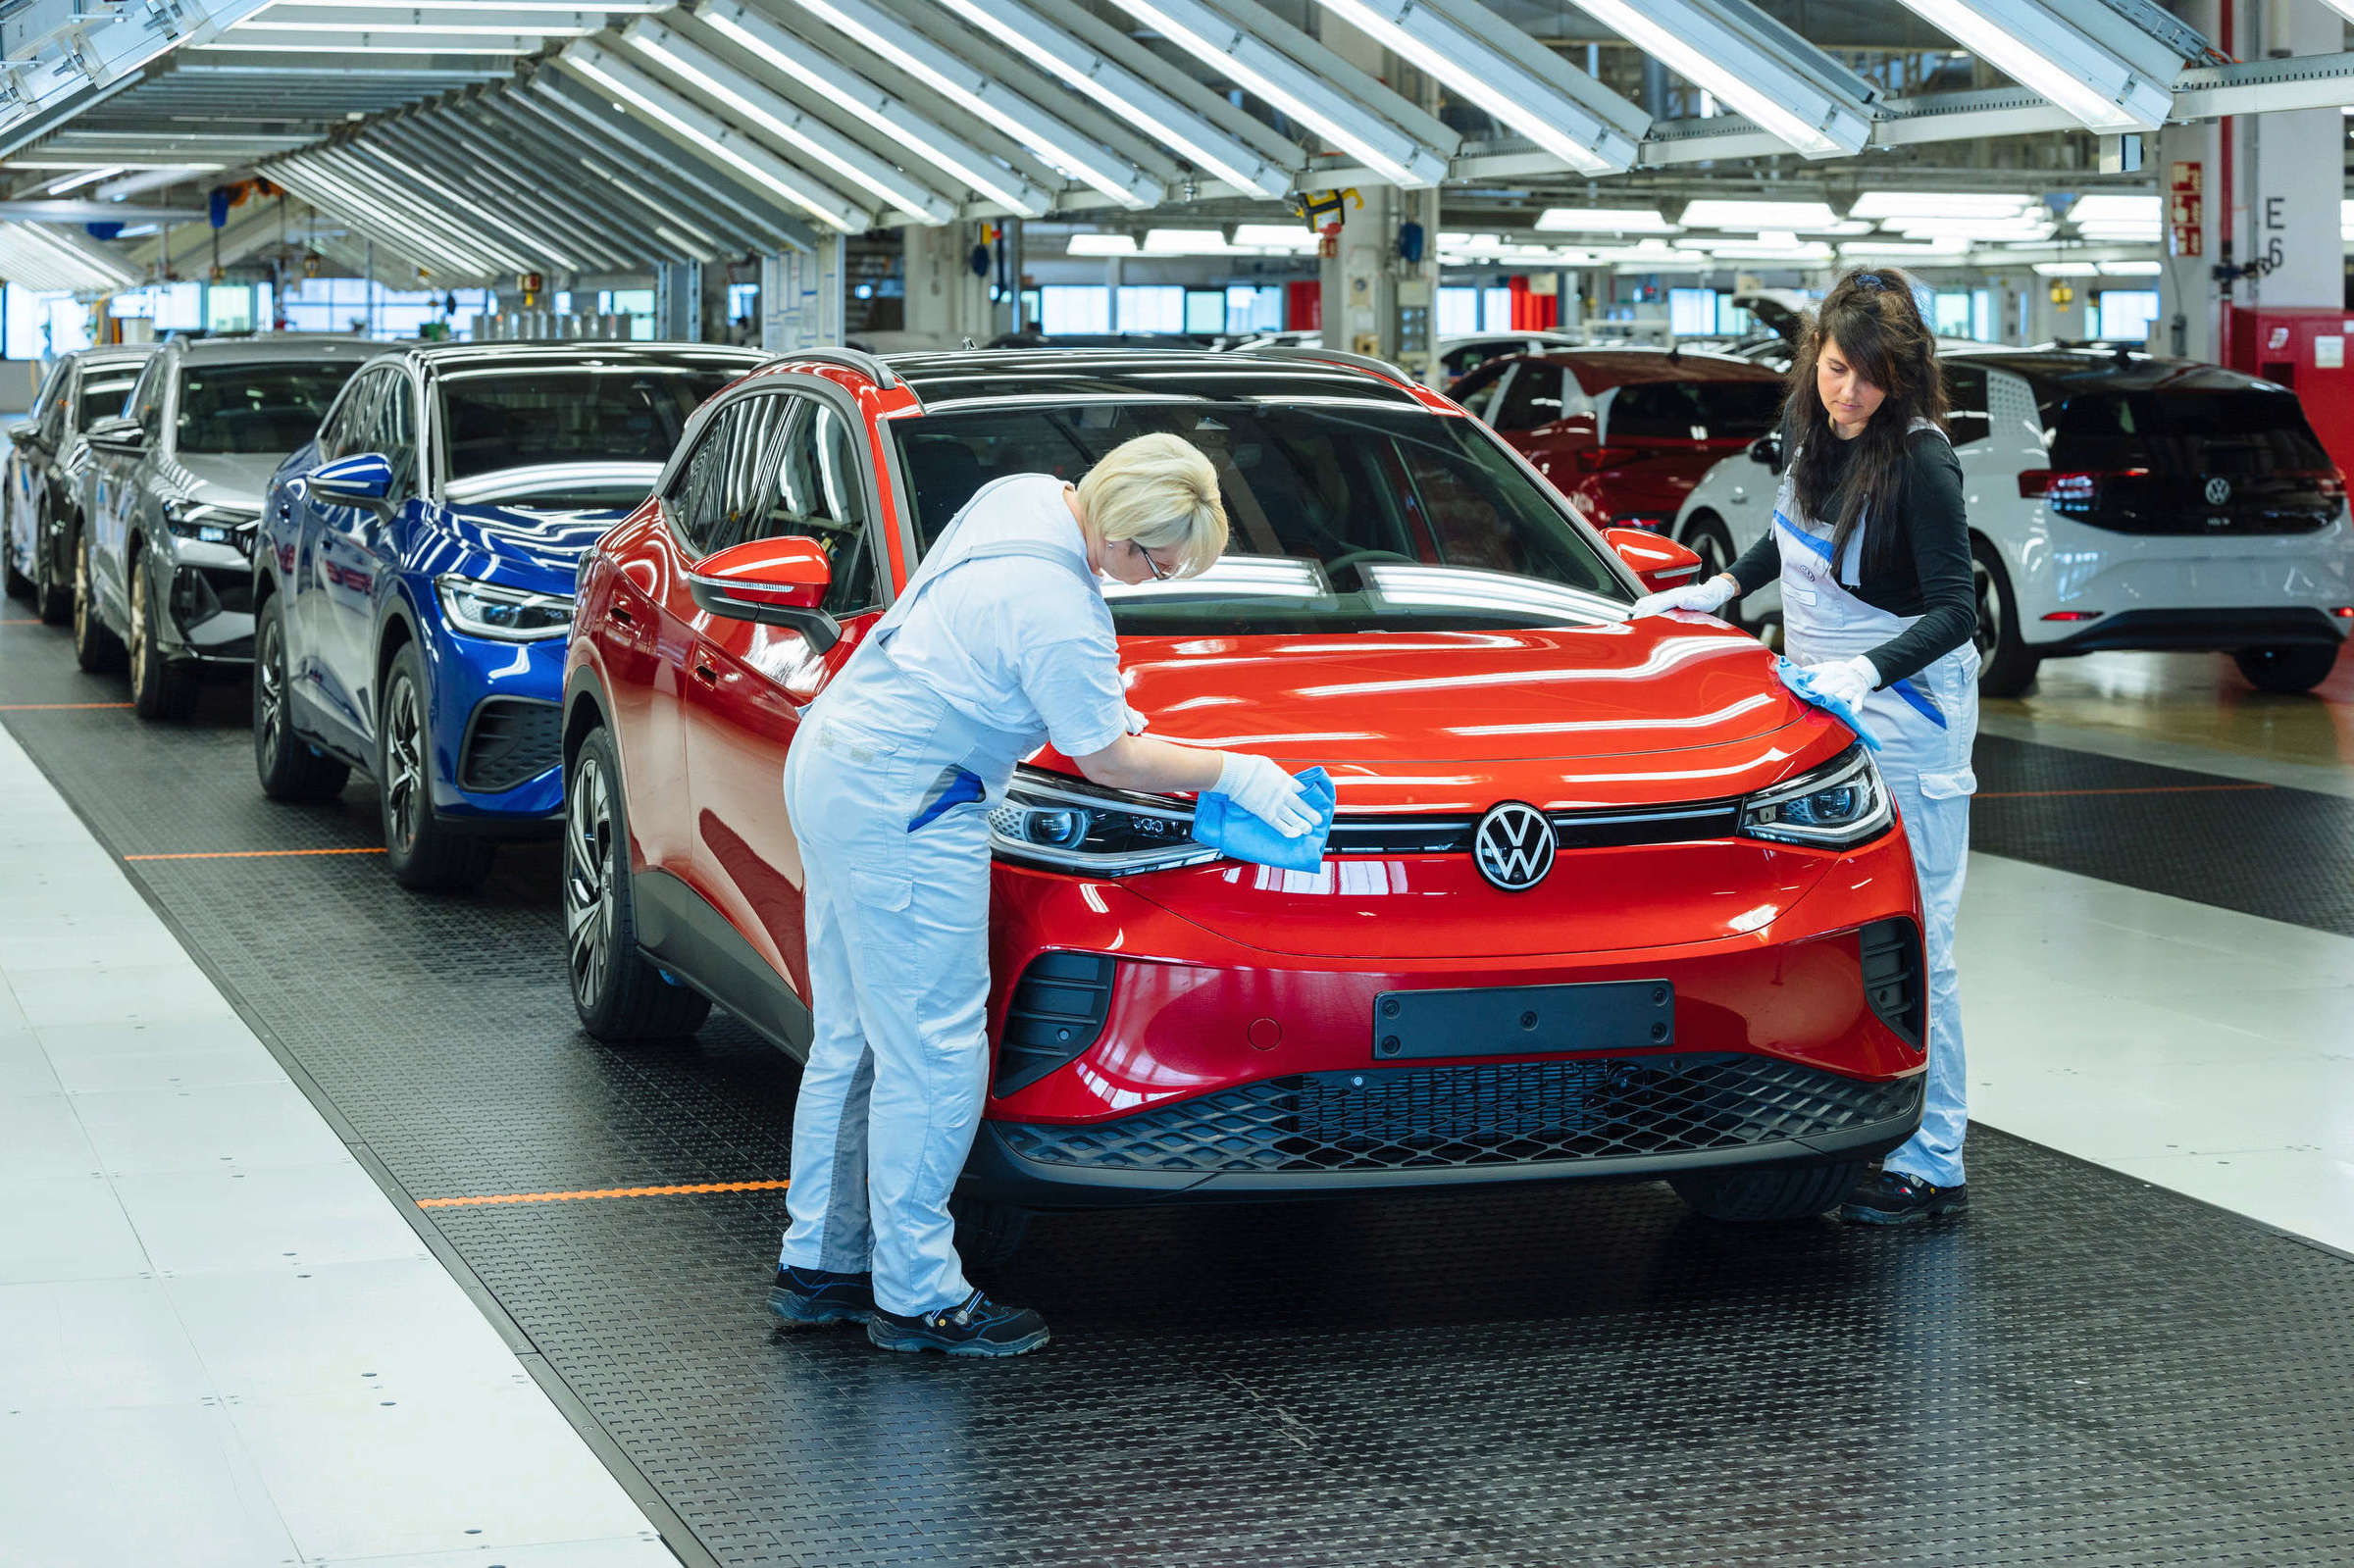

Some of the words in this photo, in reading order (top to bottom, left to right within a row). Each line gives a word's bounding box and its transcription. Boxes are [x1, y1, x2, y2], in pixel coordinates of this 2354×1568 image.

[2267, 198, 2284, 229] E
[2269, 237, 2283, 268] 6
[1478, 807, 1552, 885] VW
